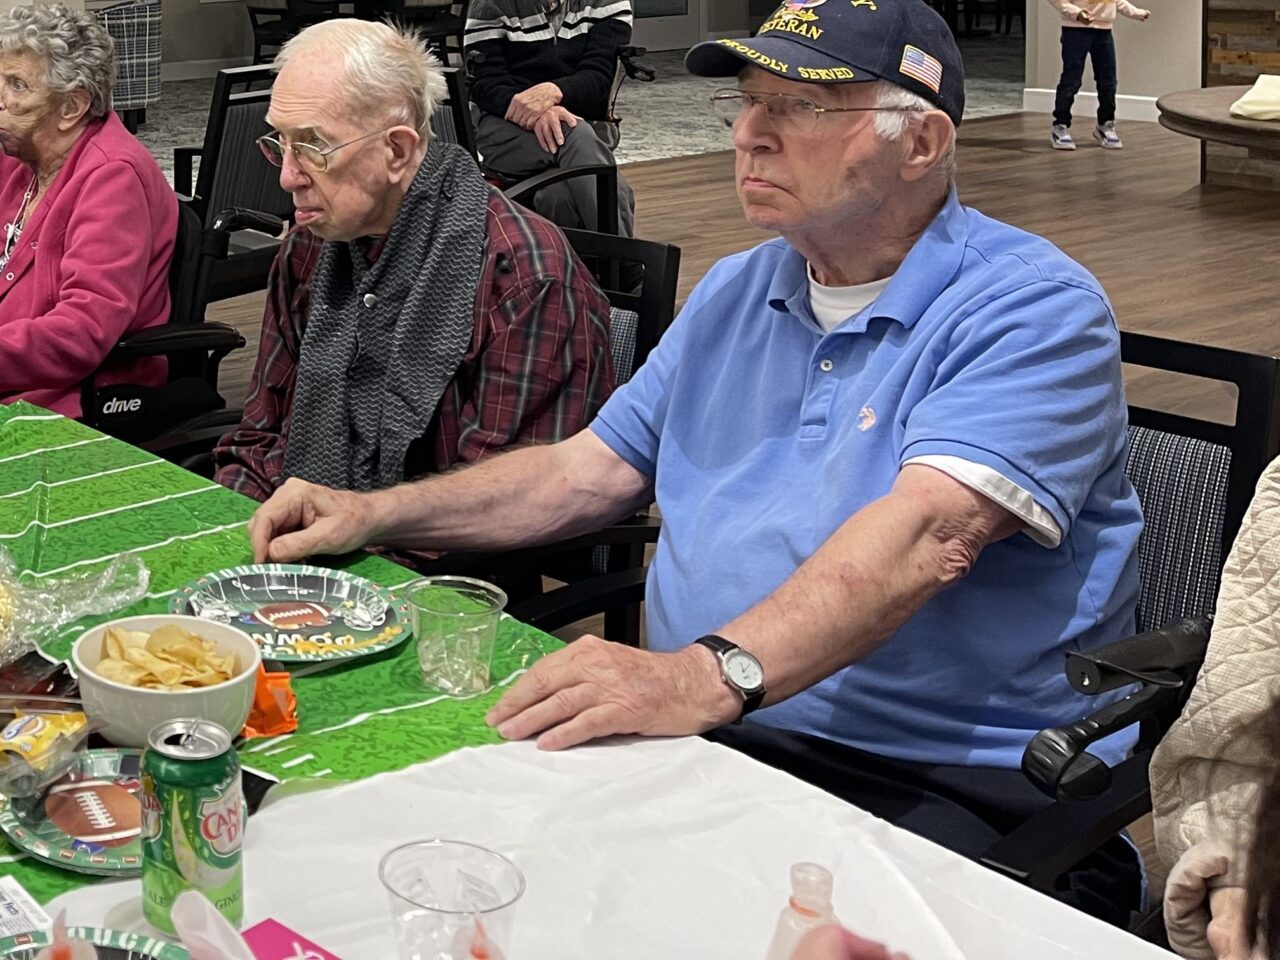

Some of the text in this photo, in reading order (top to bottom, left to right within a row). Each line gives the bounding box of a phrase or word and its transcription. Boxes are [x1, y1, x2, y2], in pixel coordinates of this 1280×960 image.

[715, 39, 855, 80] PROUDLY SERVED
[102, 397, 142, 414] drive
